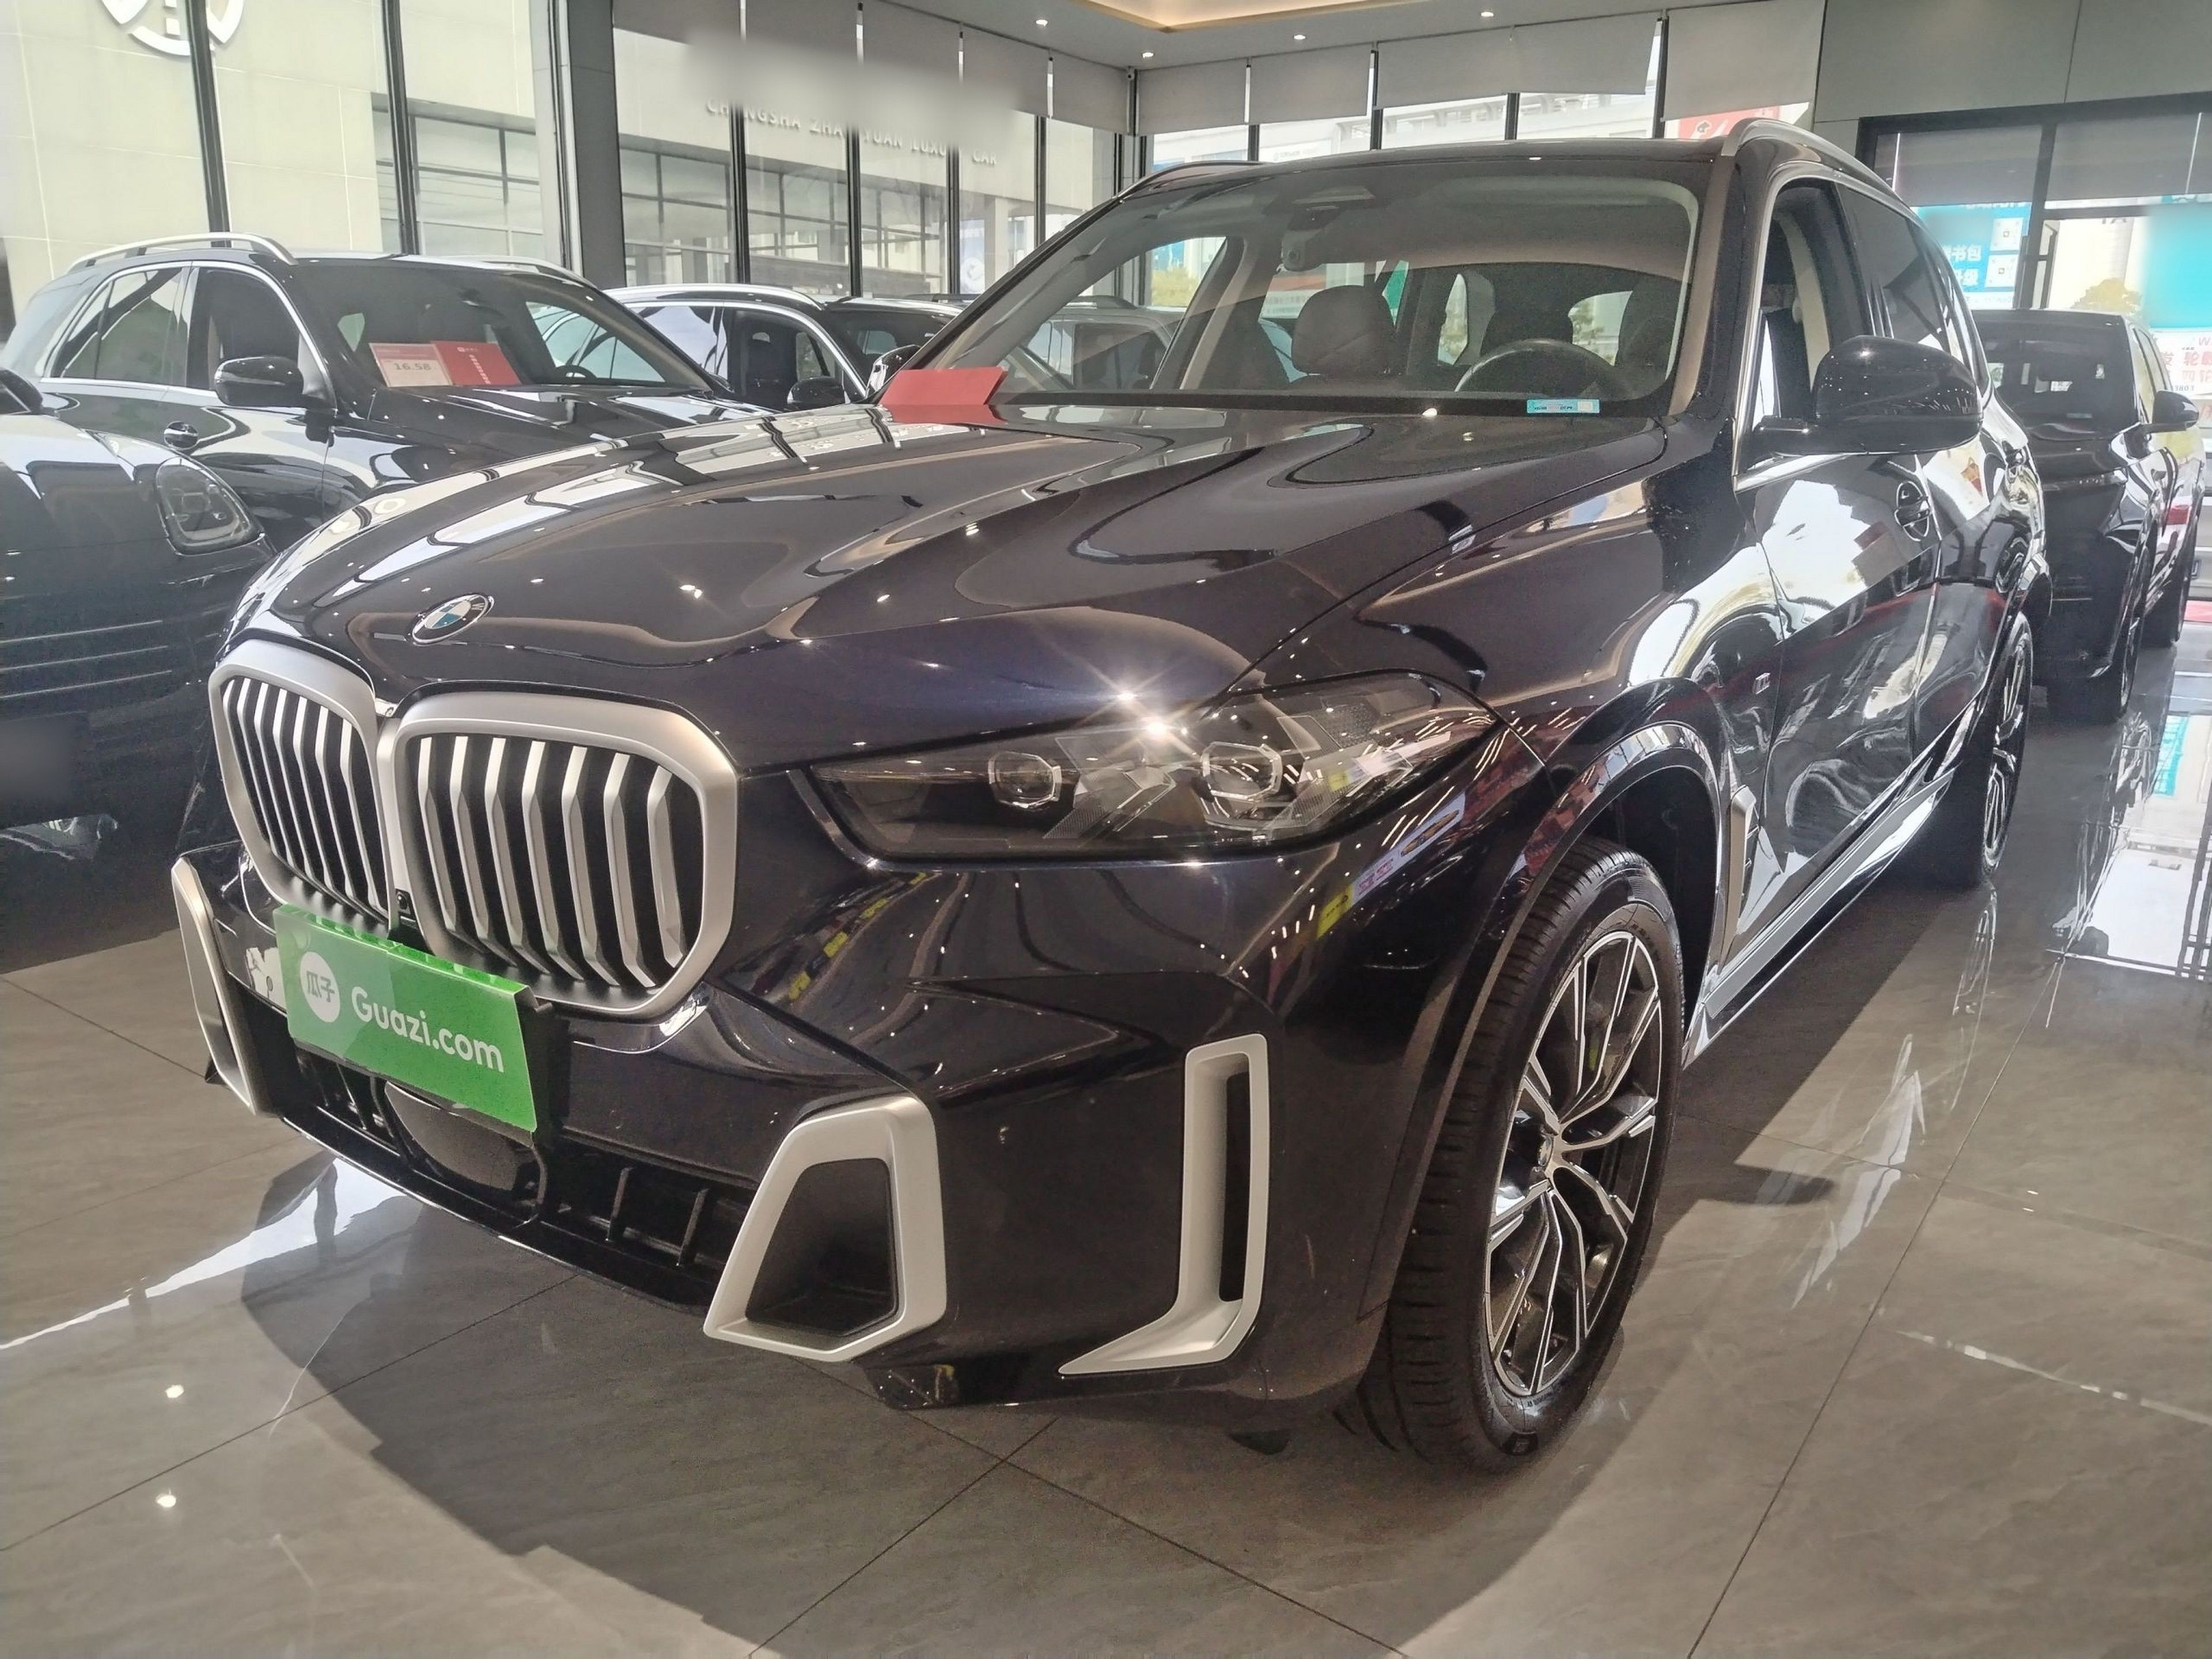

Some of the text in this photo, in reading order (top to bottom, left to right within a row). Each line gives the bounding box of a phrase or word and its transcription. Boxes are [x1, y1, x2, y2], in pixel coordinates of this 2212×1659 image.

[706, 97, 801, 130] CHNGSHA
[971, 150, 996, 165] CAR
[306, 971, 335, 1003] 瓜子
[351, 986, 505, 1073] Guazi.com
